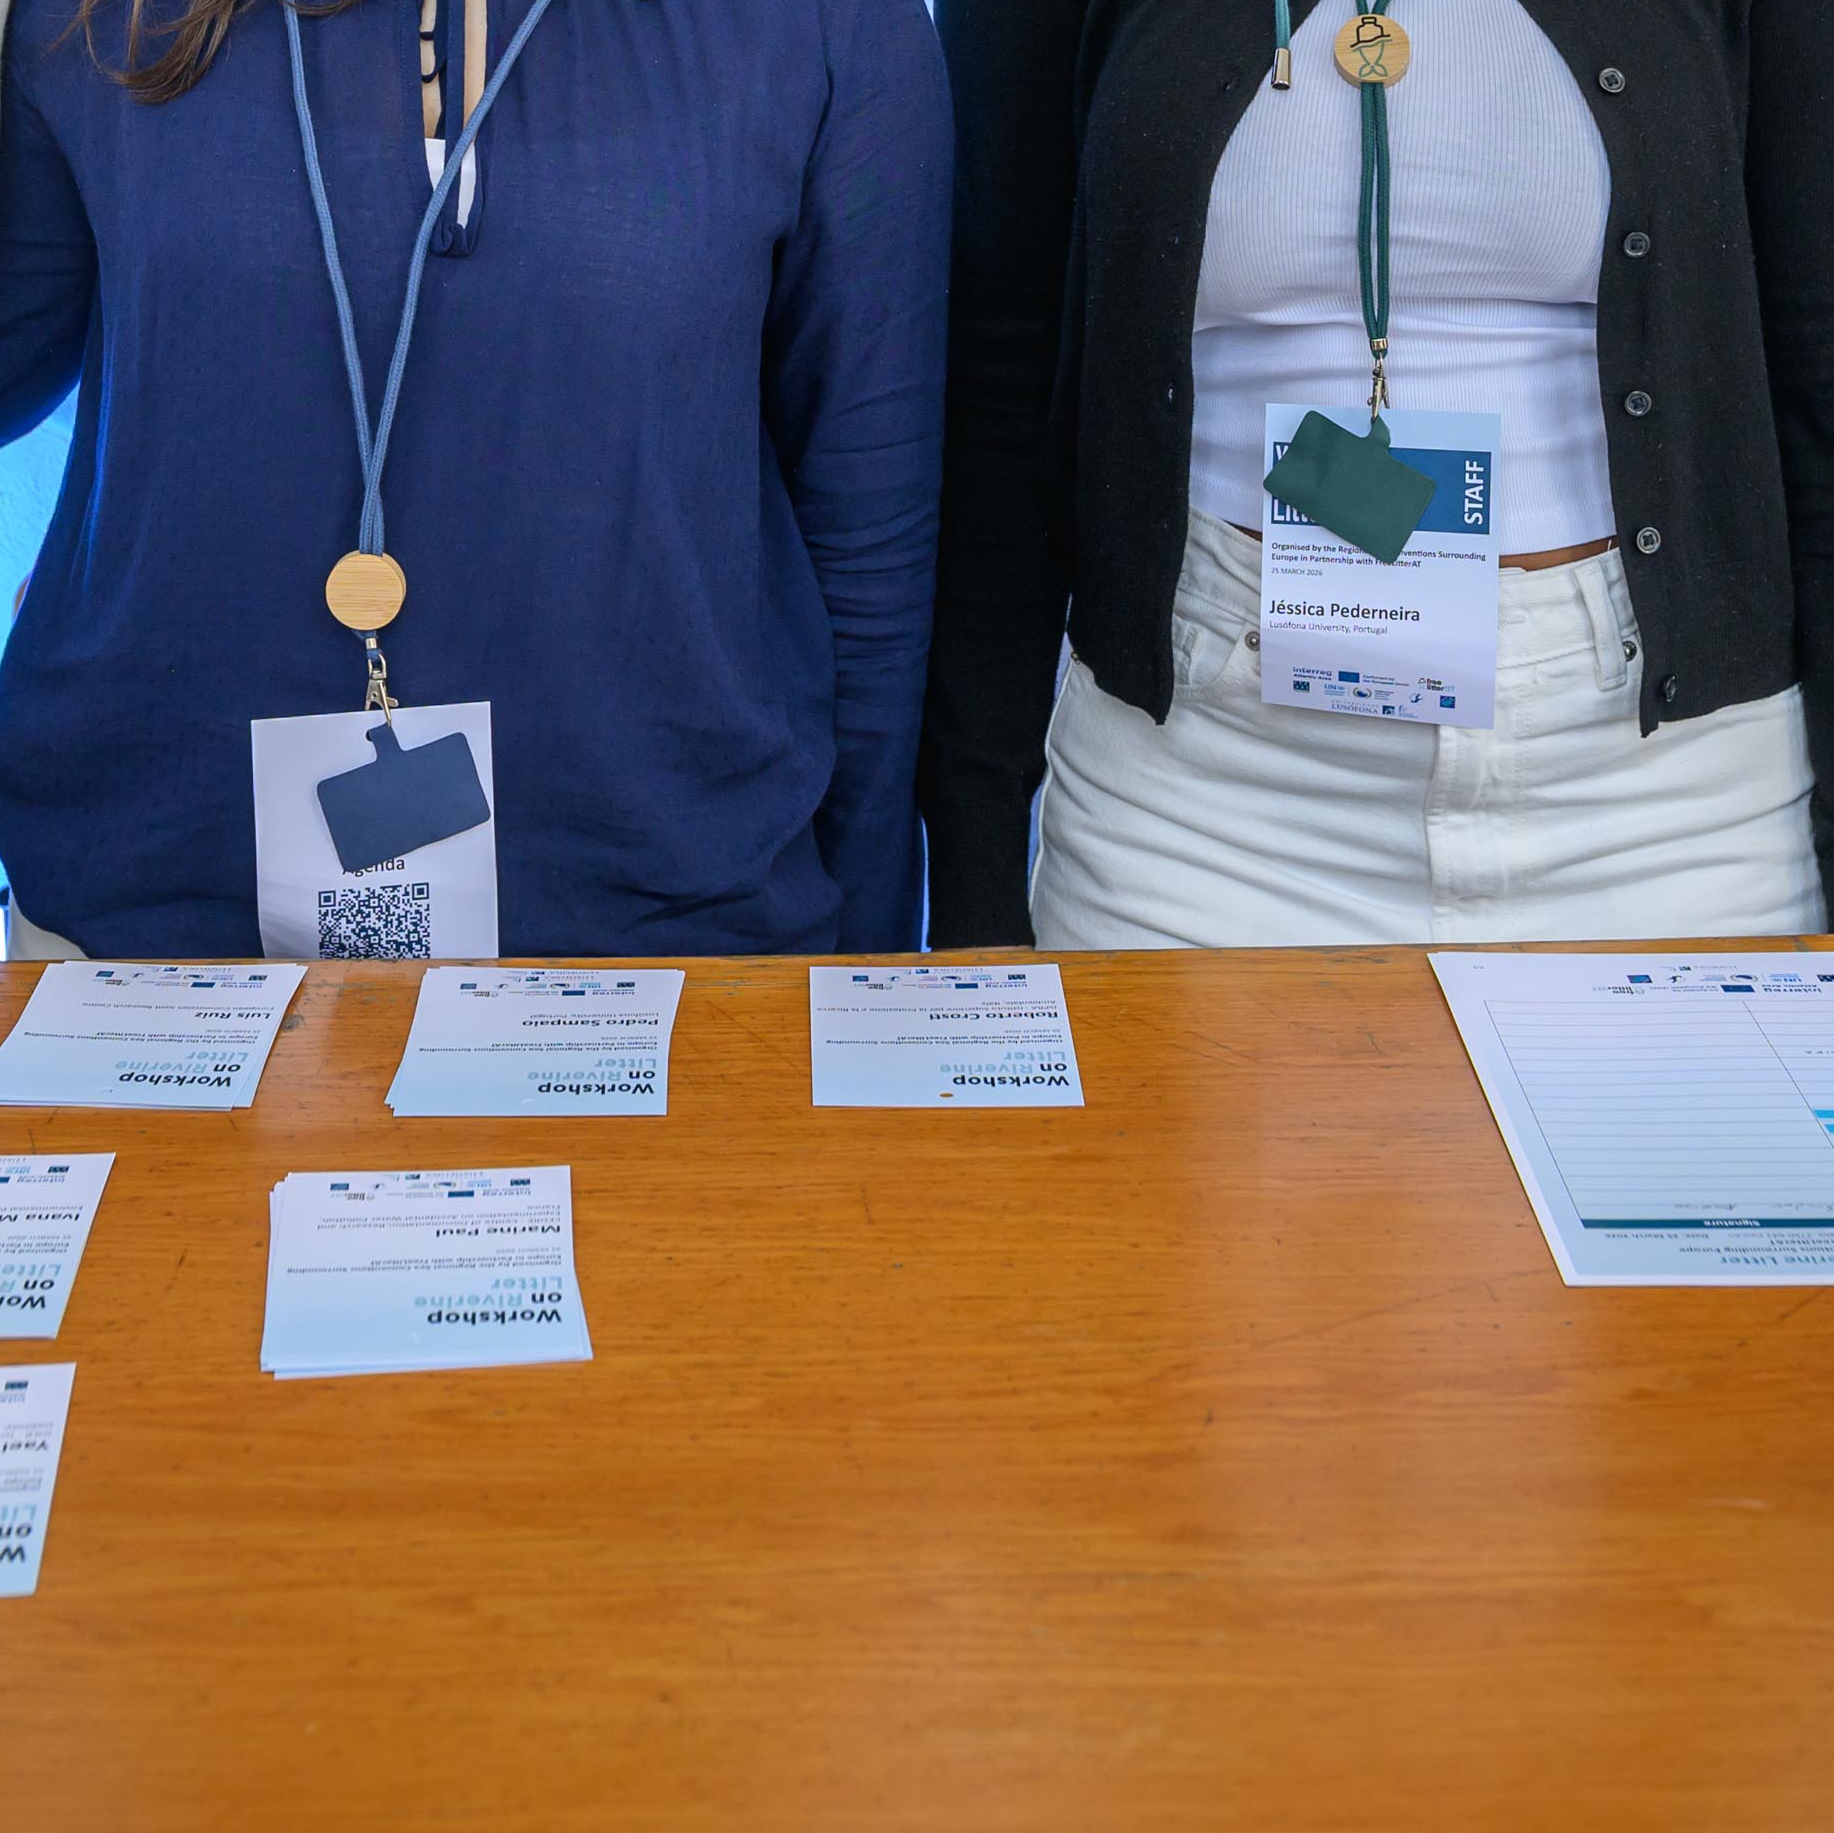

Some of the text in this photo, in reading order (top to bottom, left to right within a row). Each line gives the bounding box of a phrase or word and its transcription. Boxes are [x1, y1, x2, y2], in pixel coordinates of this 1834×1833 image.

[1464, 460, 1484, 525] STAFF
[1272, 542, 1310, 552] Organised
[1438, 550, 1486, 561] Surrounding
[1271, 553, 1298, 563] Europe
[1310, 555, 1354, 565] Partnership
[1356, 557, 1373, 565] with
[1269, 600, 1420, 621] Jéssica Pederneira
[1269, 621, 1387, 634] Lusófona University, Portugal
[522, 1018, 658, 1027] Pedro Sampaio
[185, 1052, 249, 1063] Litter
[1003, 1051, 1066, 1062] Litter
[115, 1061, 241, 1074] on Riverine
[594, 1058, 657, 1069] Litter
[940, 1063, 1067, 1075] on Riverine
[119, 1072, 231, 1088] Workshop
[527, 1071, 655, 1083] on Riverine
[953, 1075, 1069, 1087] Workshop
[537, 1083, 654, 1096] Workshop
[1703, 1219, 1760, 1227] Signature
[436, 1225, 560, 1237] Marine Paul
[1718, 1256, 1777, 1266] Litter
[24, 1280, 55, 1291] on
[490, 1276, 562, 1291] Litter
[414, 1292, 562, 1310] on Riverine
[427, 1309, 562, 1326] Workshop
